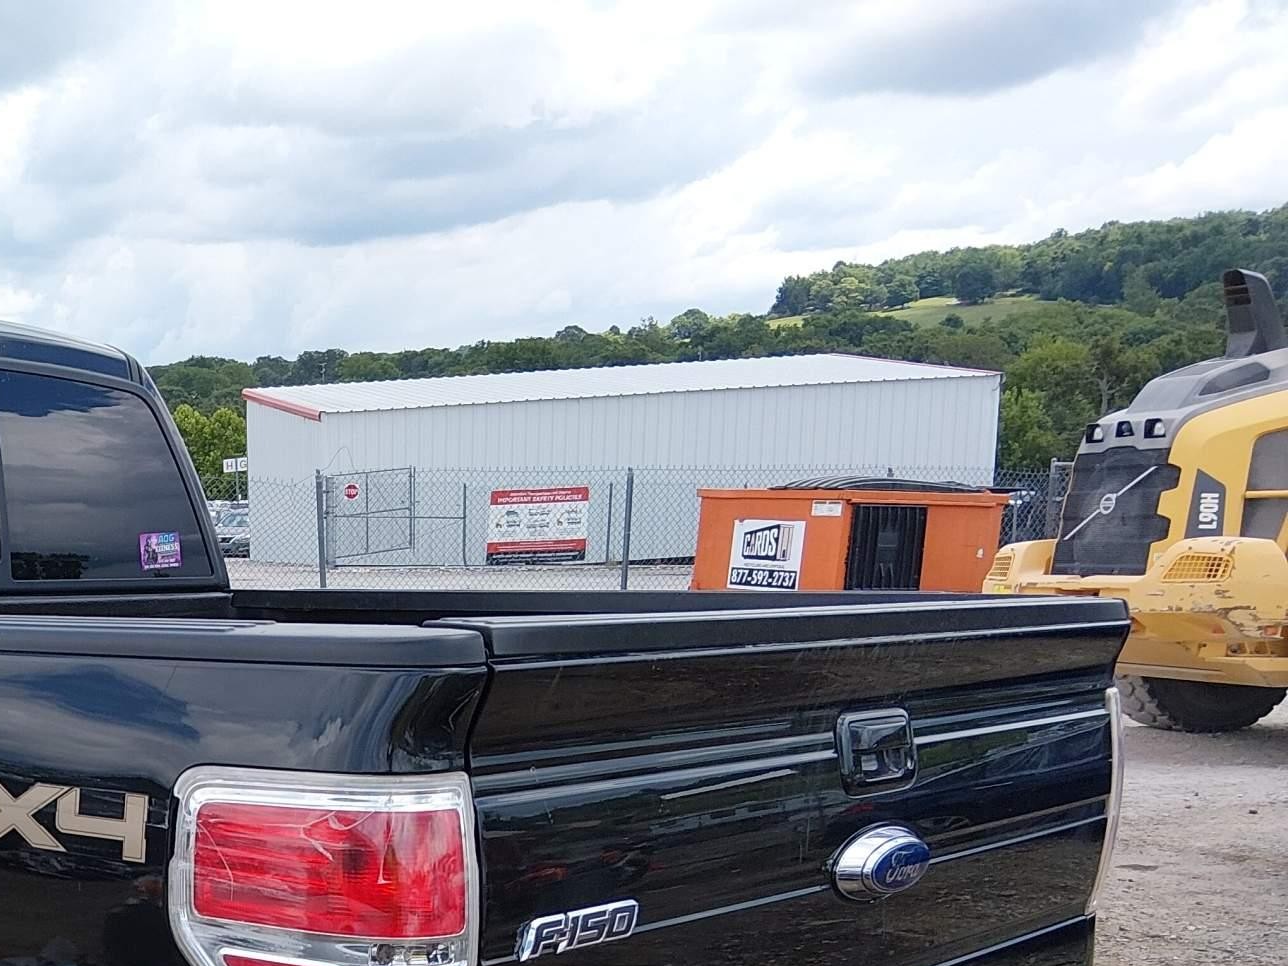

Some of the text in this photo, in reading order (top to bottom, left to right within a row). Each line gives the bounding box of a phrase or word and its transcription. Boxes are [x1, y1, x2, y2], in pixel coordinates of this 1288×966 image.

[1198, 493, 1220, 529] L90H
[743, 528, 779, 556] CARDS
[731, 568, 796, 587] 877-592-2737
[885, 845, 921, 883] Ford
